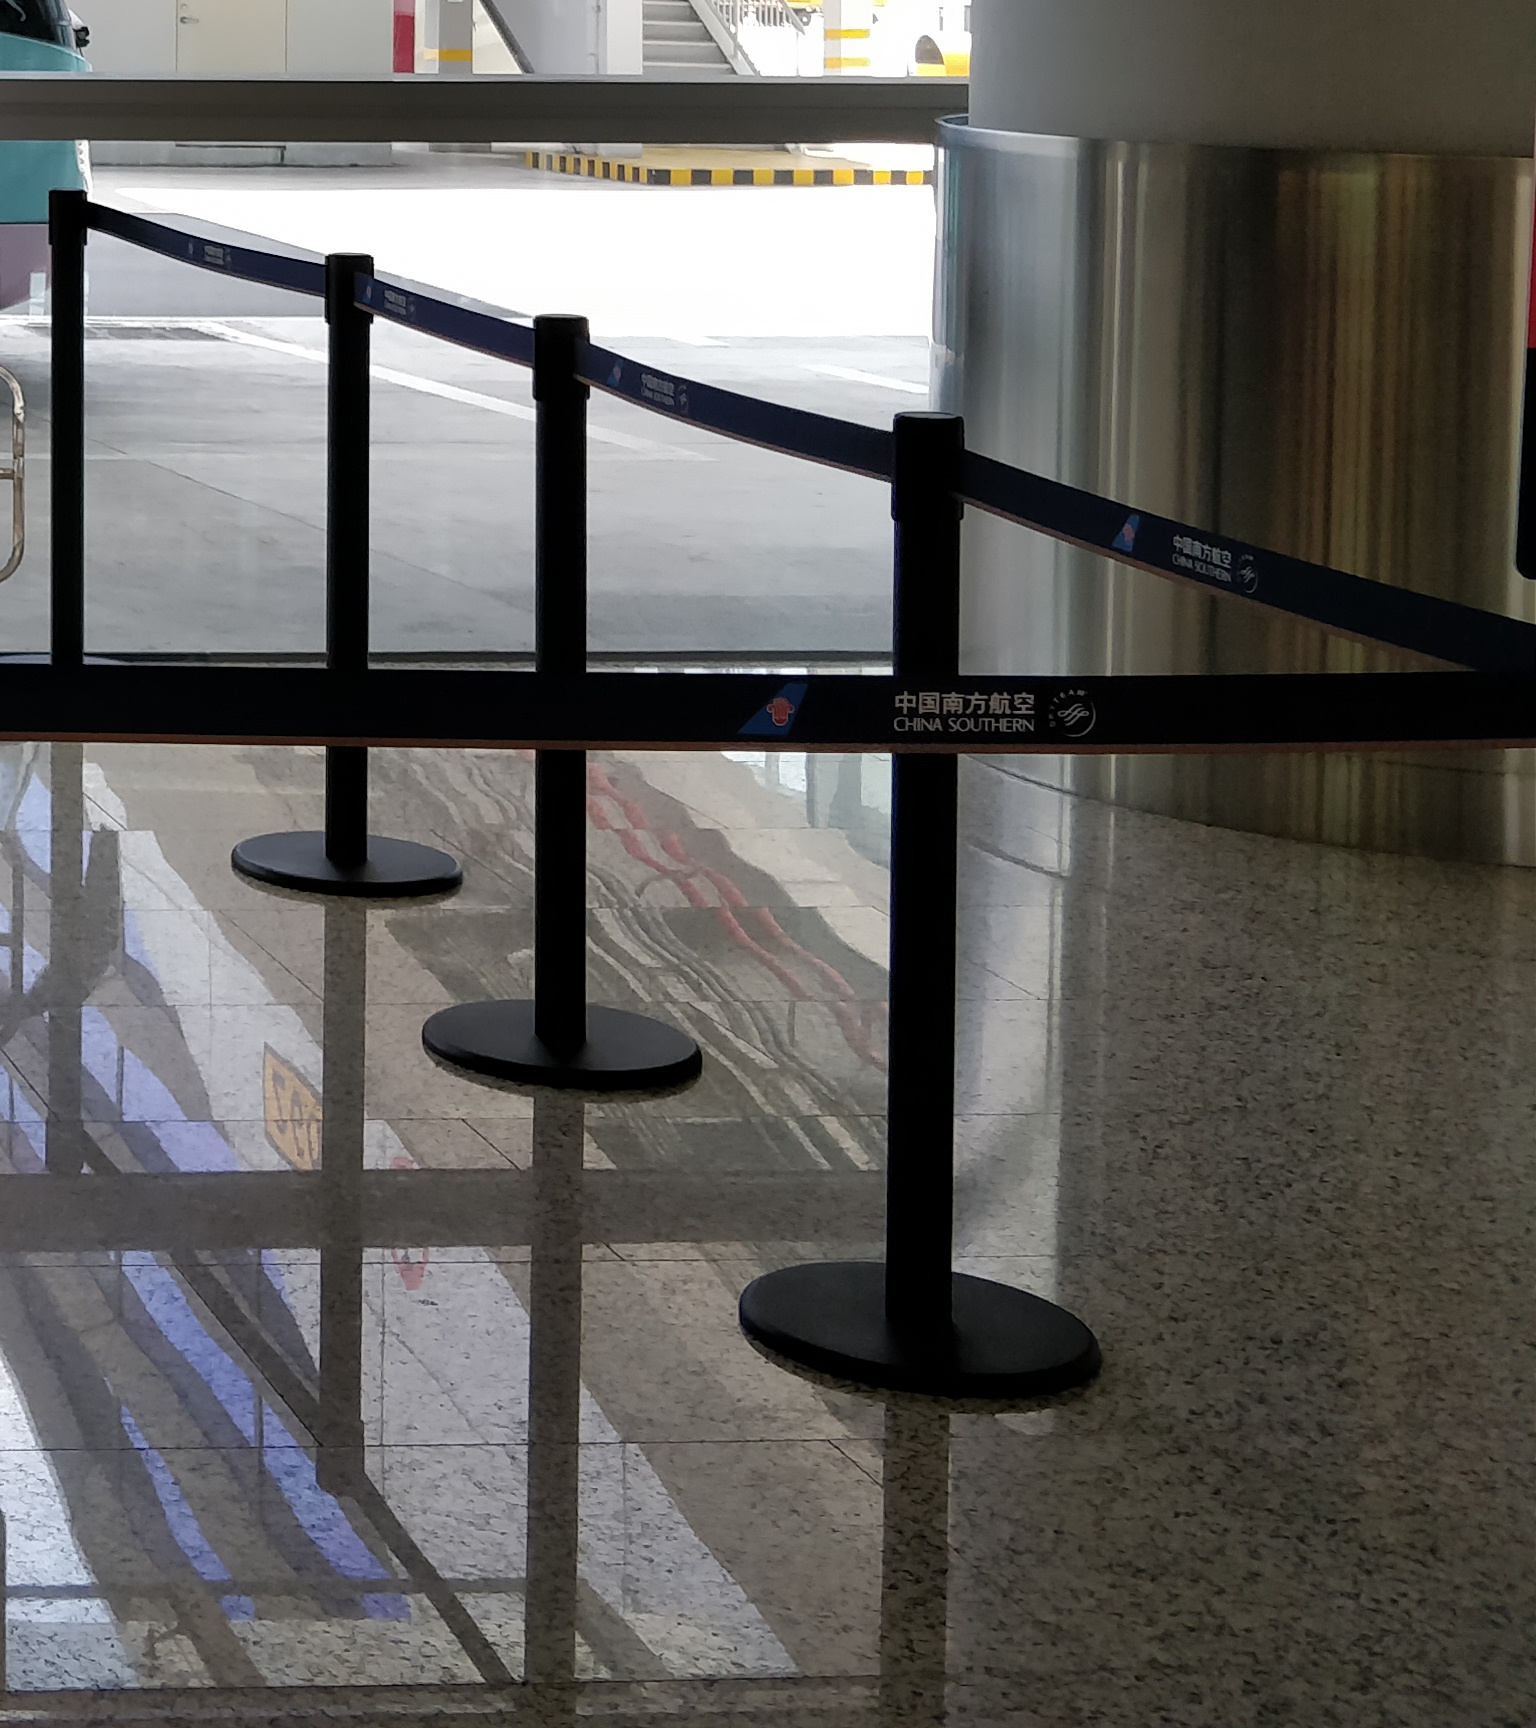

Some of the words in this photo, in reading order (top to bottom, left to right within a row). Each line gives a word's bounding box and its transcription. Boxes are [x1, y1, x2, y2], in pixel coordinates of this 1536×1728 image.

[894, 691, 1035, 715] 中国南方航空
[894, 718, 943, 732] CHINA
[948, 718, 1035, 732] SOUTHERN
